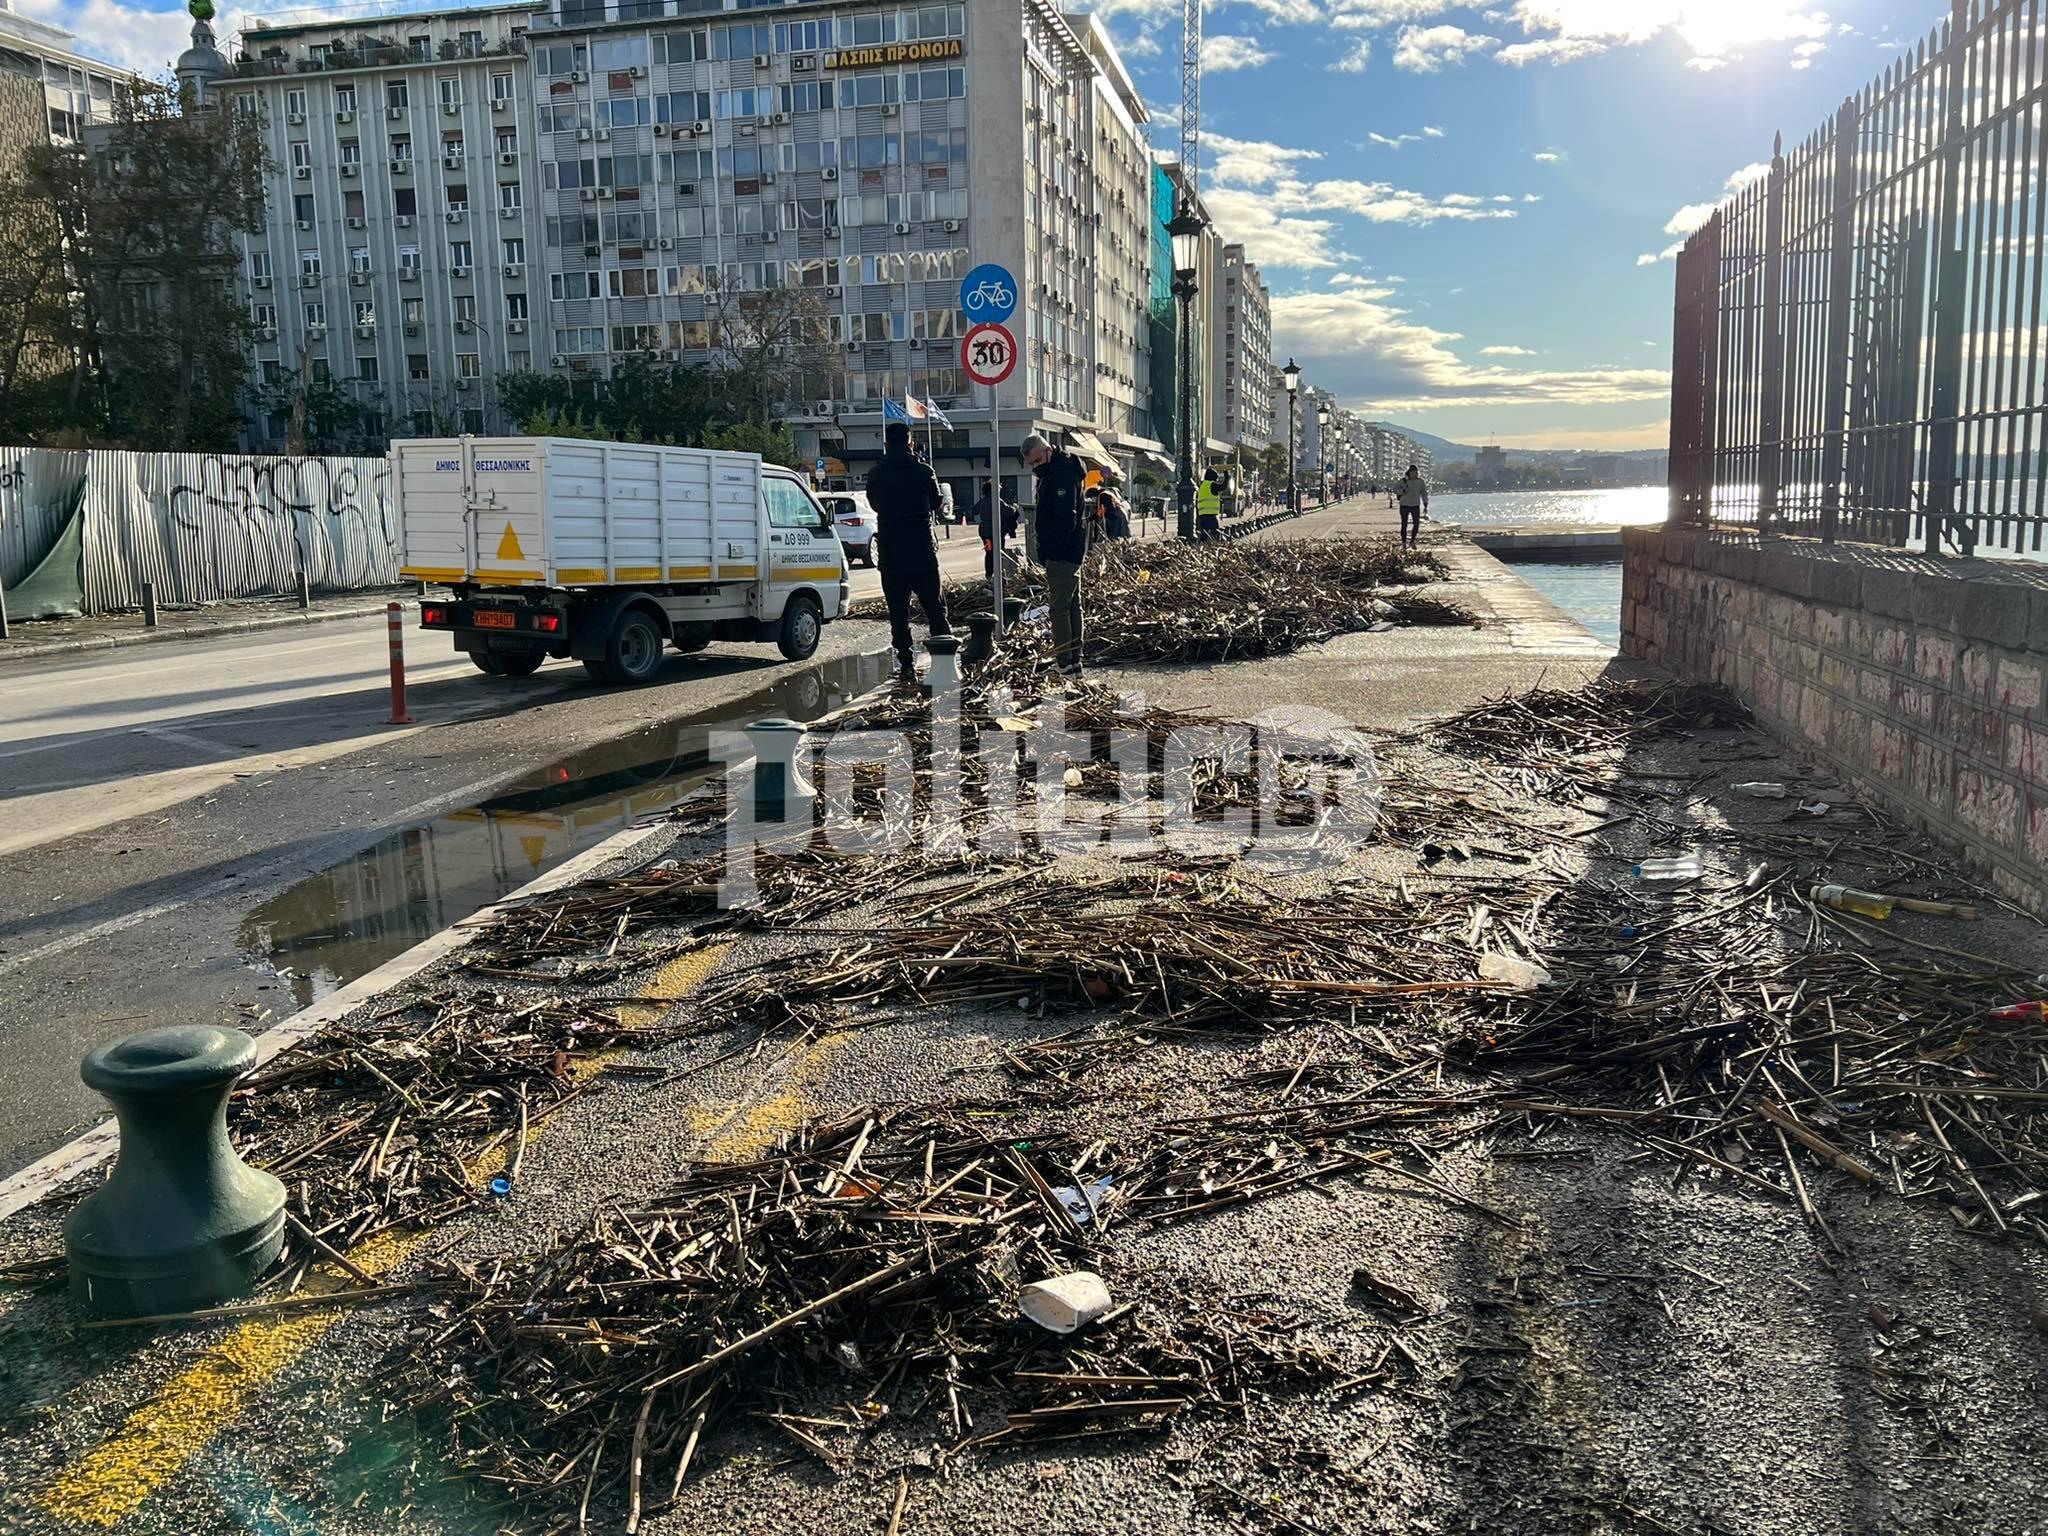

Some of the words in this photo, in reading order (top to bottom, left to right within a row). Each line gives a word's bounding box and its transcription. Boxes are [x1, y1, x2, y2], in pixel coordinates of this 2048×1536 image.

[839, 48, 884, 66] ΑΣΠΙΣ
[887, 40, 960, 61] ΠΡΟΝΟΙΑ
[972, 340, 1004, 366] 30
[435, 460, 460, 471] ΔΗΜΟΣ
[475, 460, 531, 471] ΘΕΣΣΑΛΟΝΙΚΗΣ
[797, 533, 810, 546] 999
